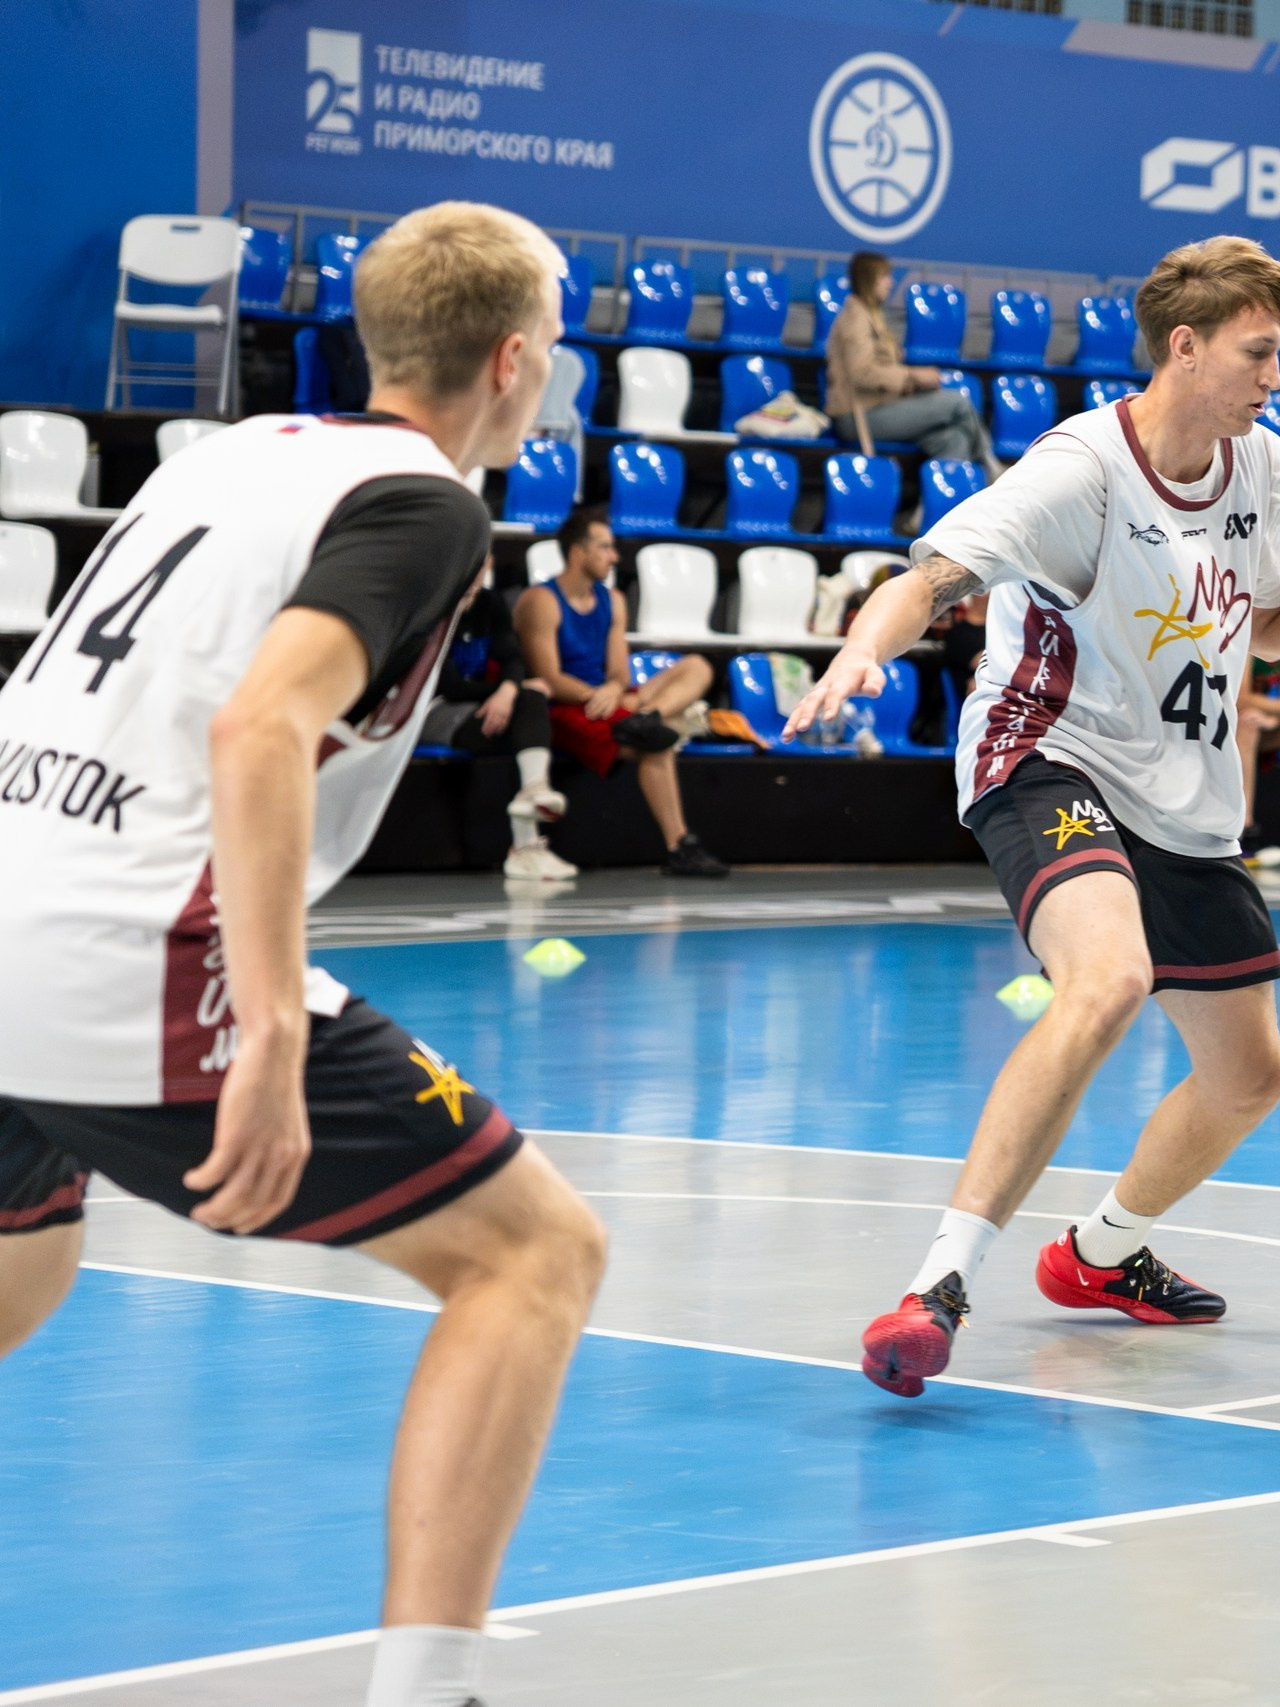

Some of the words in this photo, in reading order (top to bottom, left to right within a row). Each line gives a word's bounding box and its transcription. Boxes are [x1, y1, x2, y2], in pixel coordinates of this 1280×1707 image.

[376, 45, 545, 91] ТЕЛЕВИДЕНИЕ
[375, 83, 393, 111] И
[398, 85, 481, 121] РАДИО
[374, 121, 550, 165] ПРИМОРСКОГО
[554, 138, 615, 170] КРАЯ
[27, 512, 212, 694] 14
[1160, 660, 1228, 752] 47
